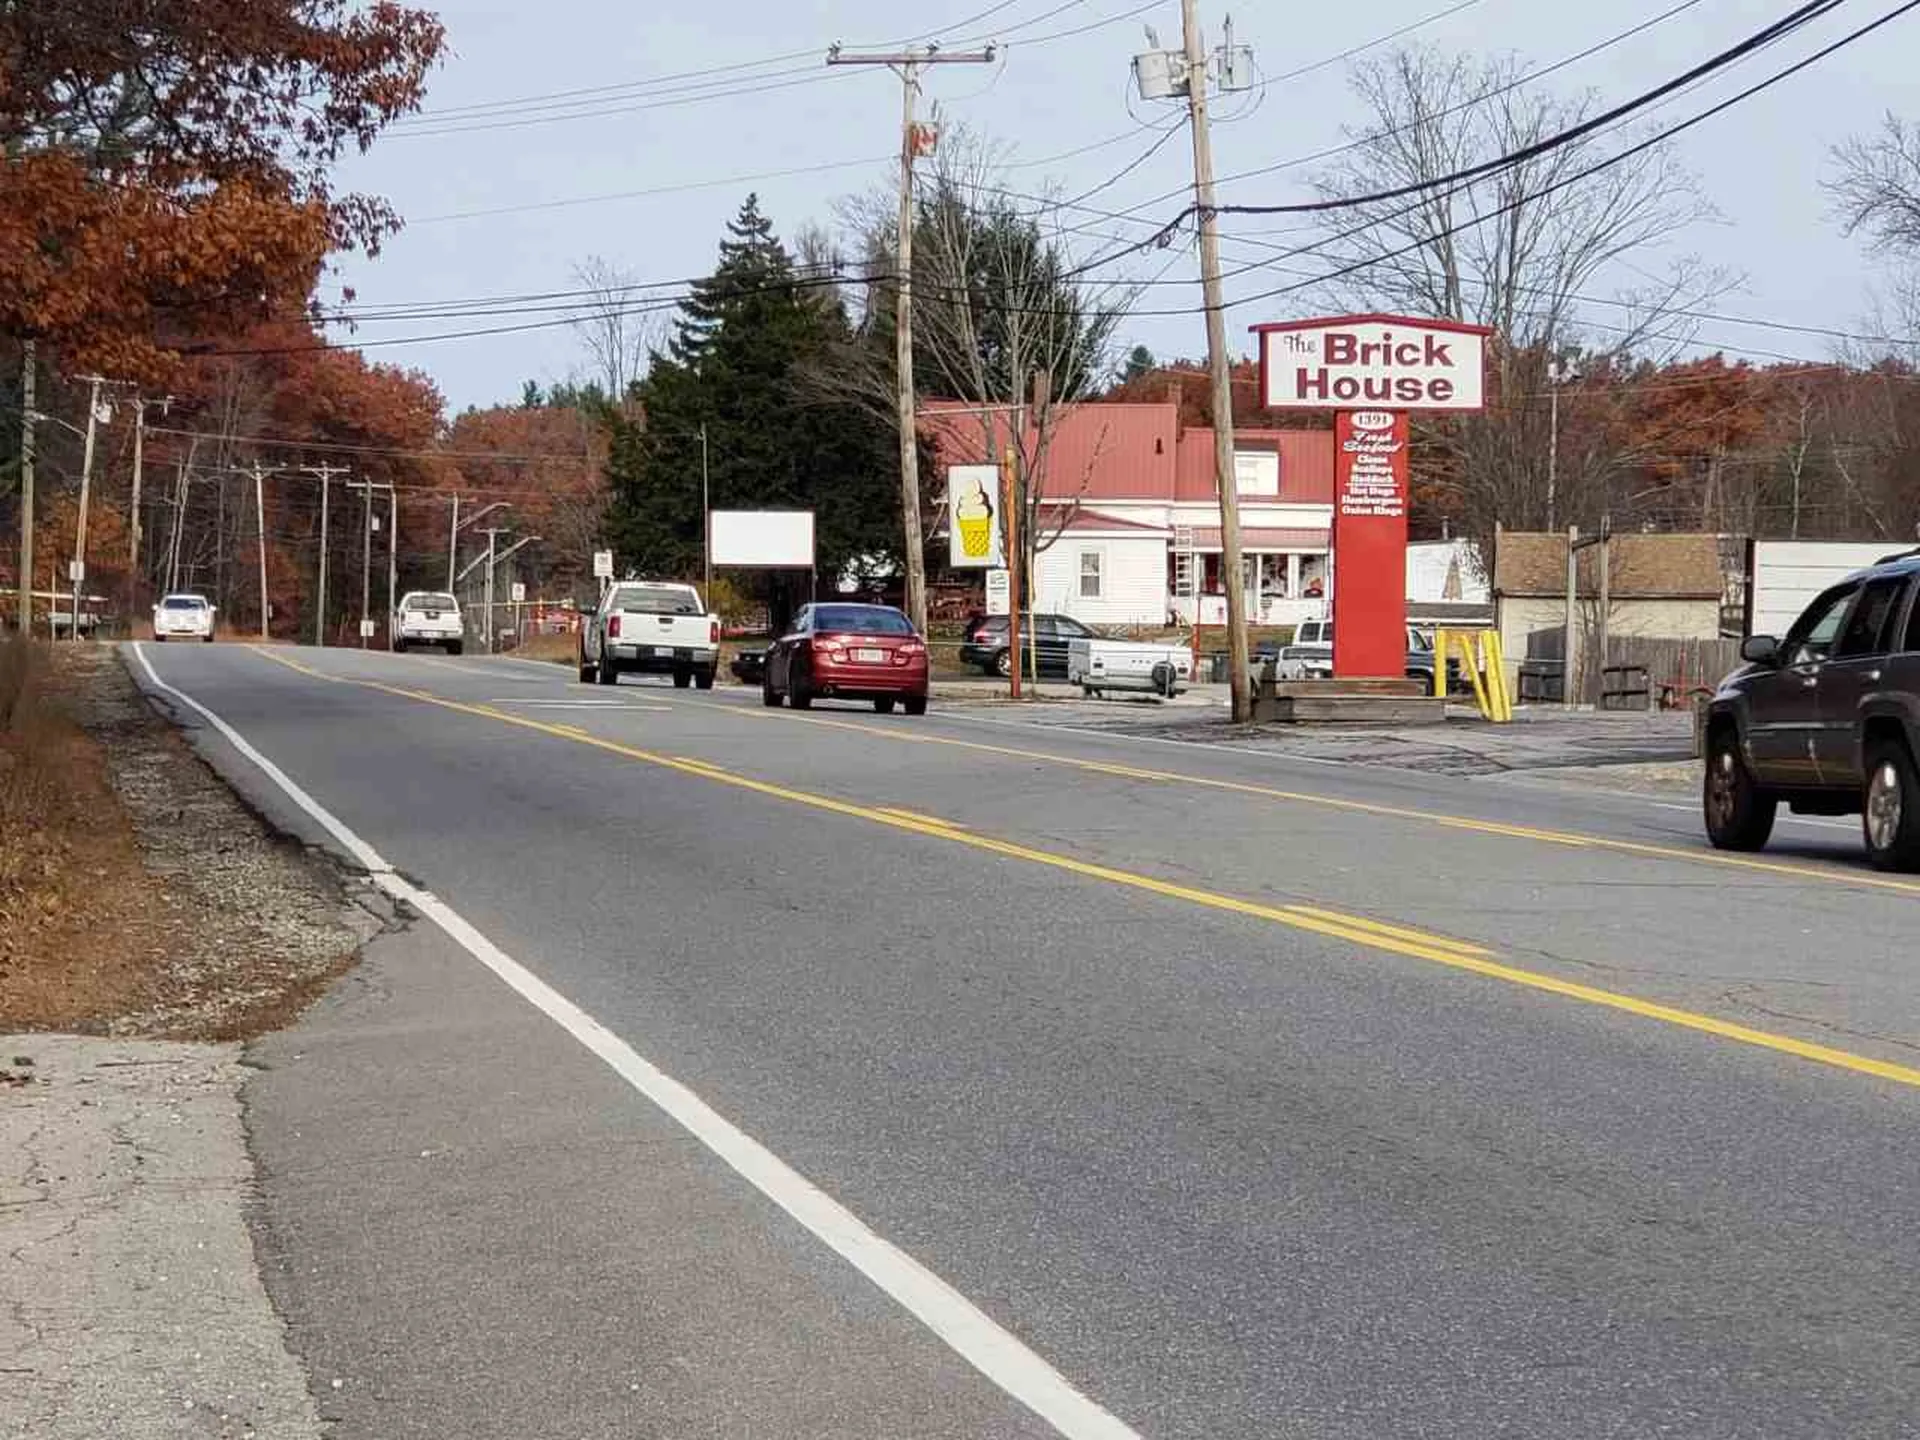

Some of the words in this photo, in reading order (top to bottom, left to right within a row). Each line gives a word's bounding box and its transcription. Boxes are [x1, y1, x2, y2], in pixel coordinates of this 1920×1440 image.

[1284, 333, 1317, 354] The
[1324, 333, 1454, 367] Brick
[1296, 367, 1454, 401] House
